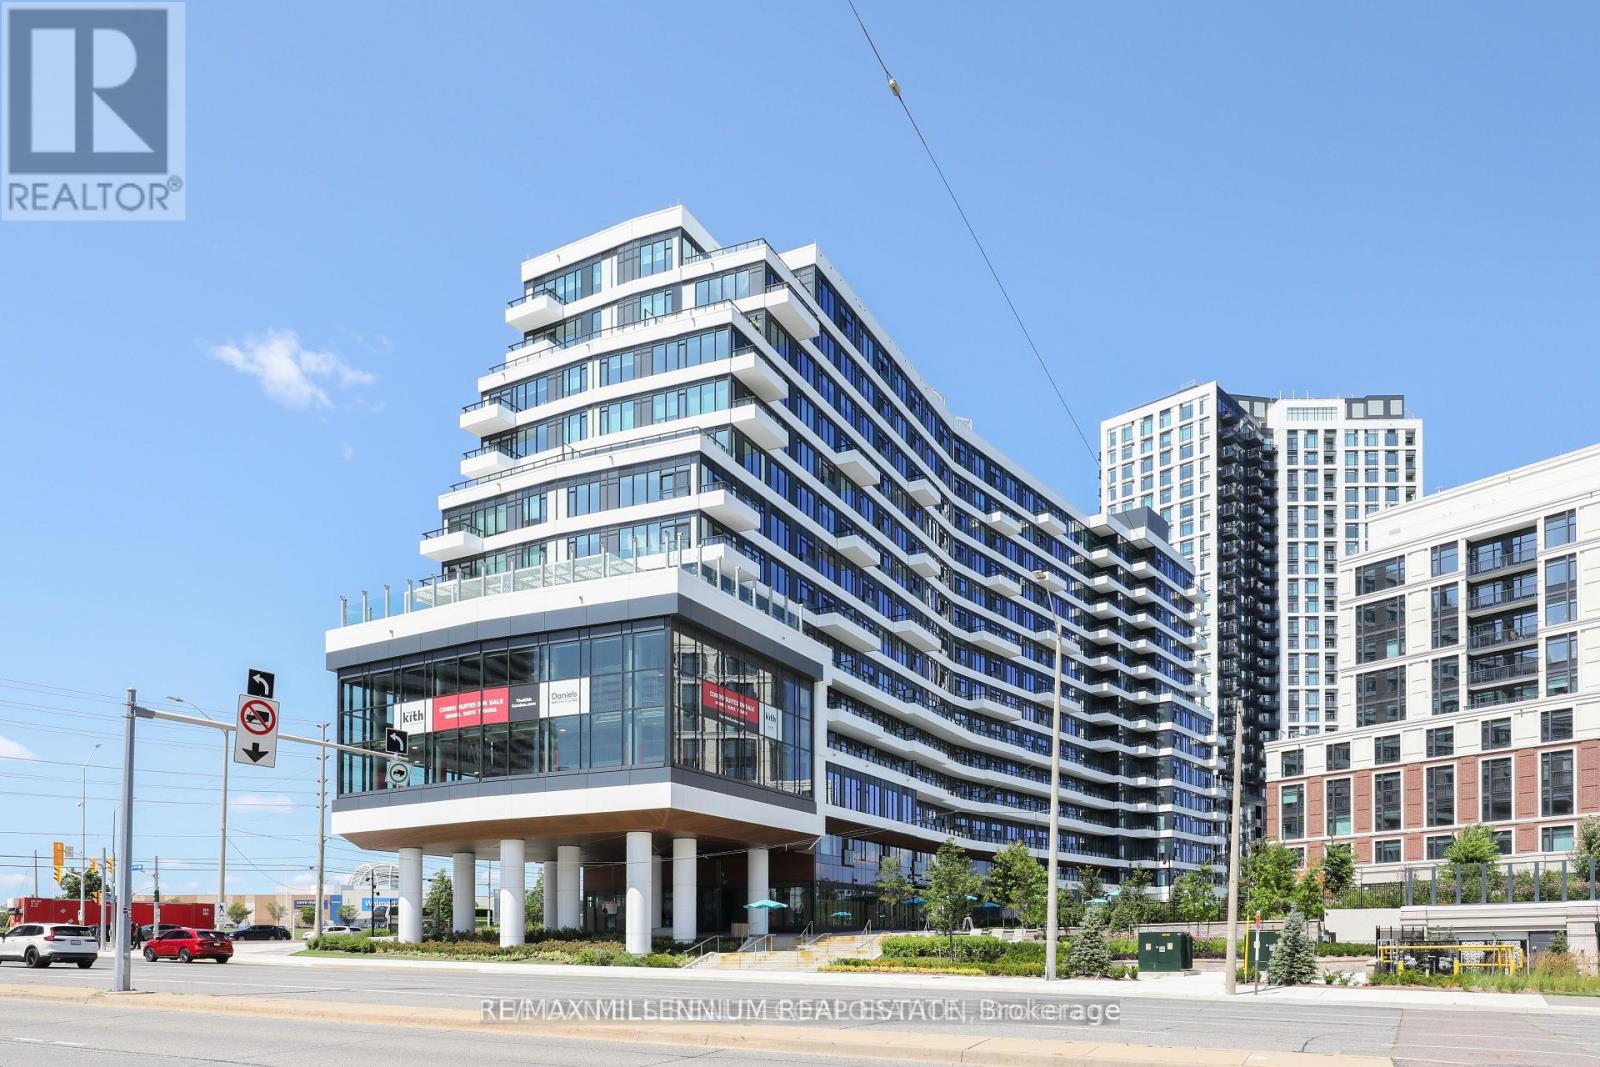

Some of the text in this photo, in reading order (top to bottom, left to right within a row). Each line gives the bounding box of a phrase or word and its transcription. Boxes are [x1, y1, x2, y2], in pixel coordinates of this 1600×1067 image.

[551, 690, 578, 700] Daniels
[489, 698, 504, 706] SALE
[403, 709, 424, 723] kith
[765, 712, 777, 723] kith
